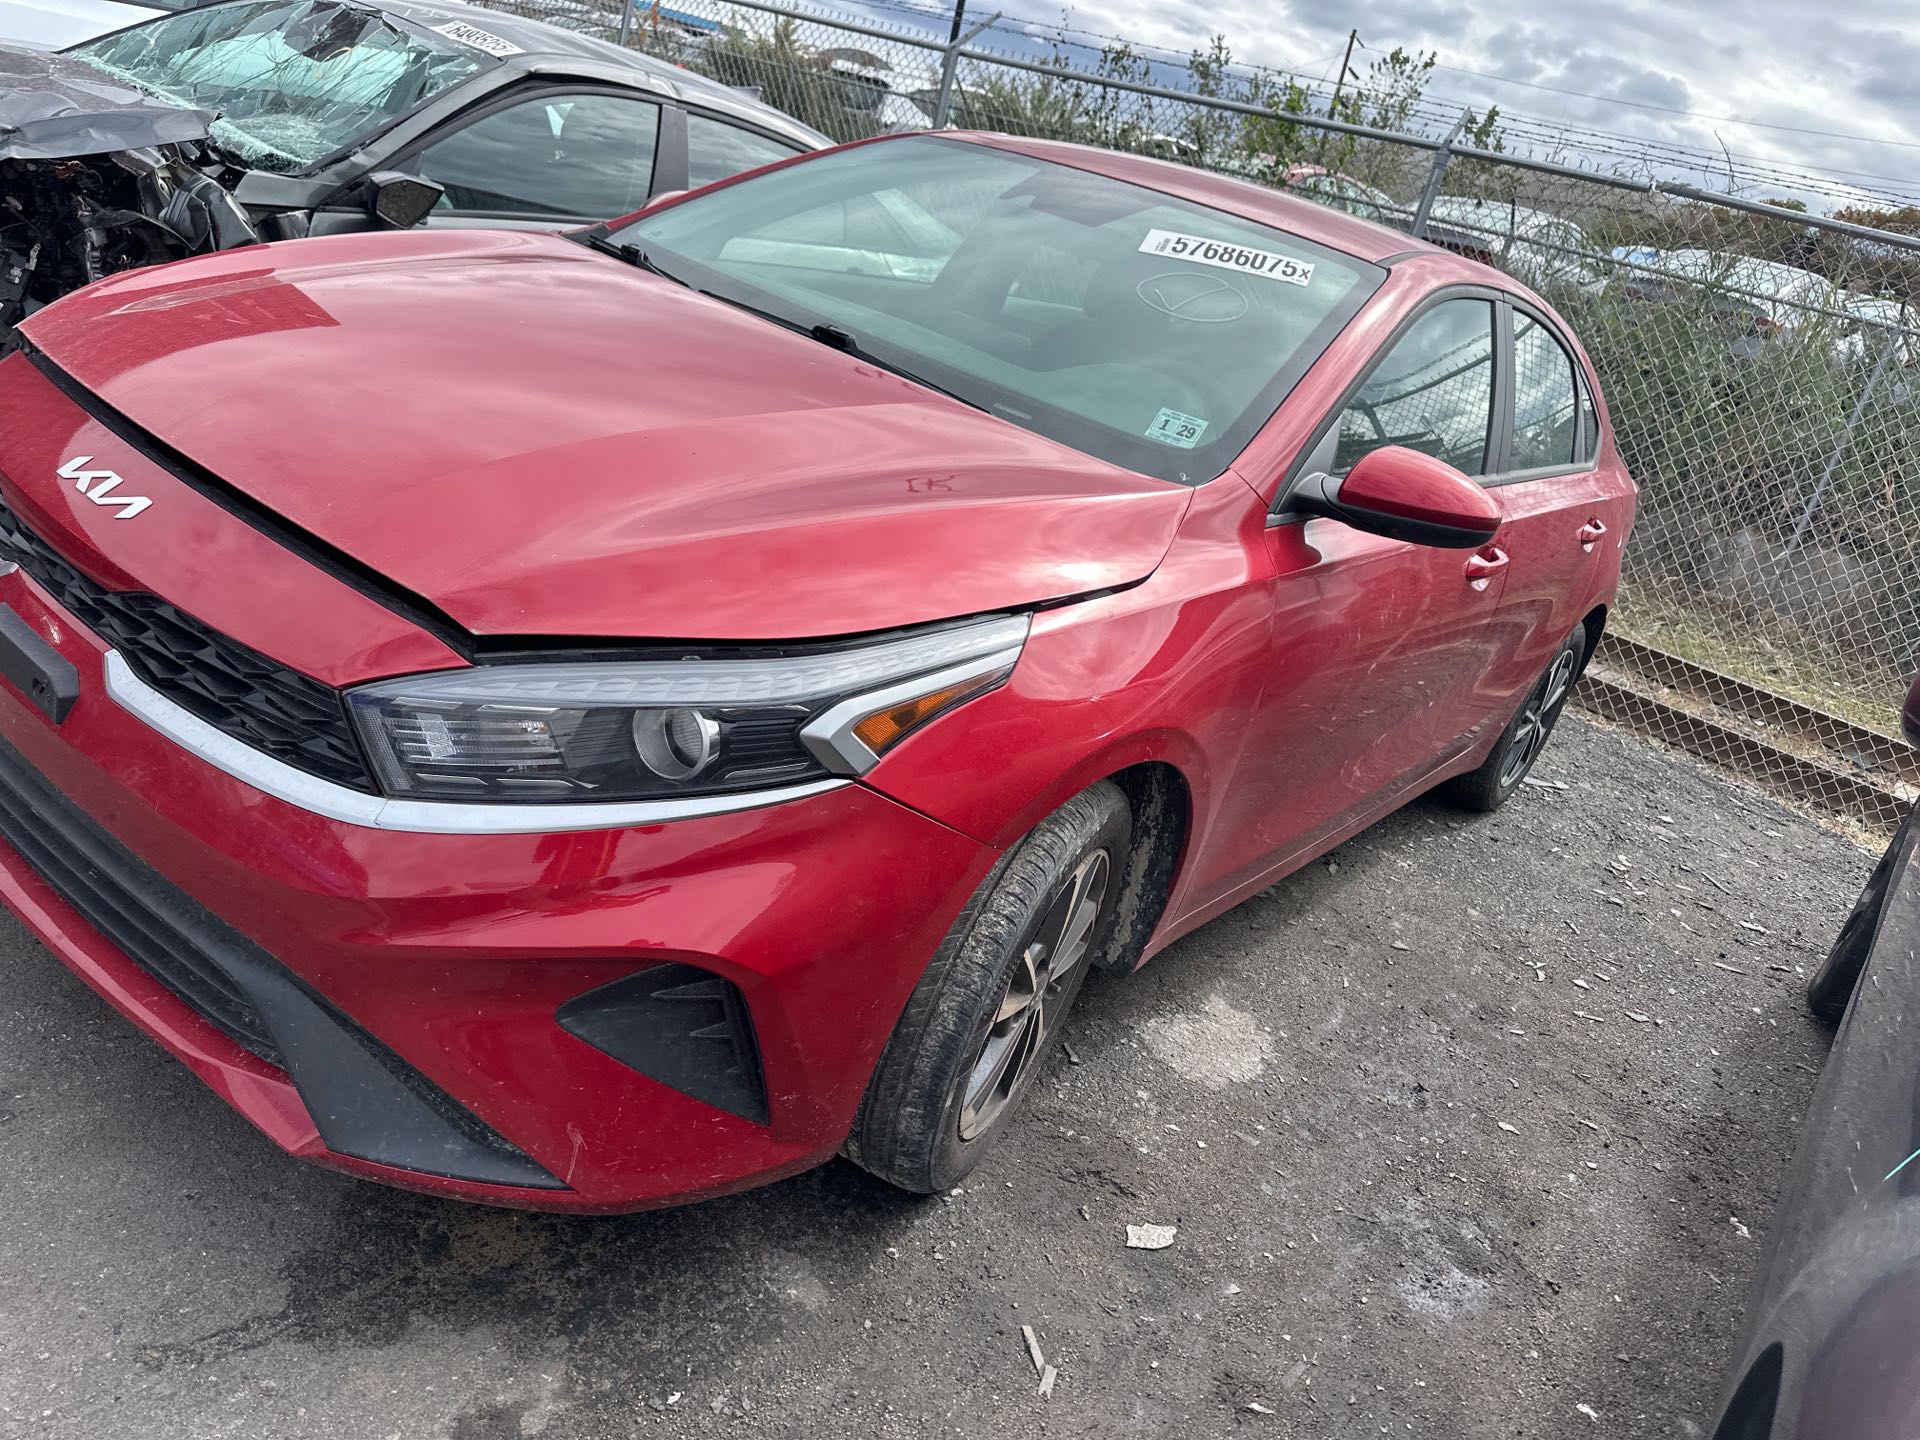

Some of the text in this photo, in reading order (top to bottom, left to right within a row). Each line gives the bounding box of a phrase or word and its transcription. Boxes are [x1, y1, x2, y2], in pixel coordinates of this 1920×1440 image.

[1159, 419, 1171, 431] 1
[1176, 425, 1196, 439] 29
[56, 455, 153, 519] KIA
